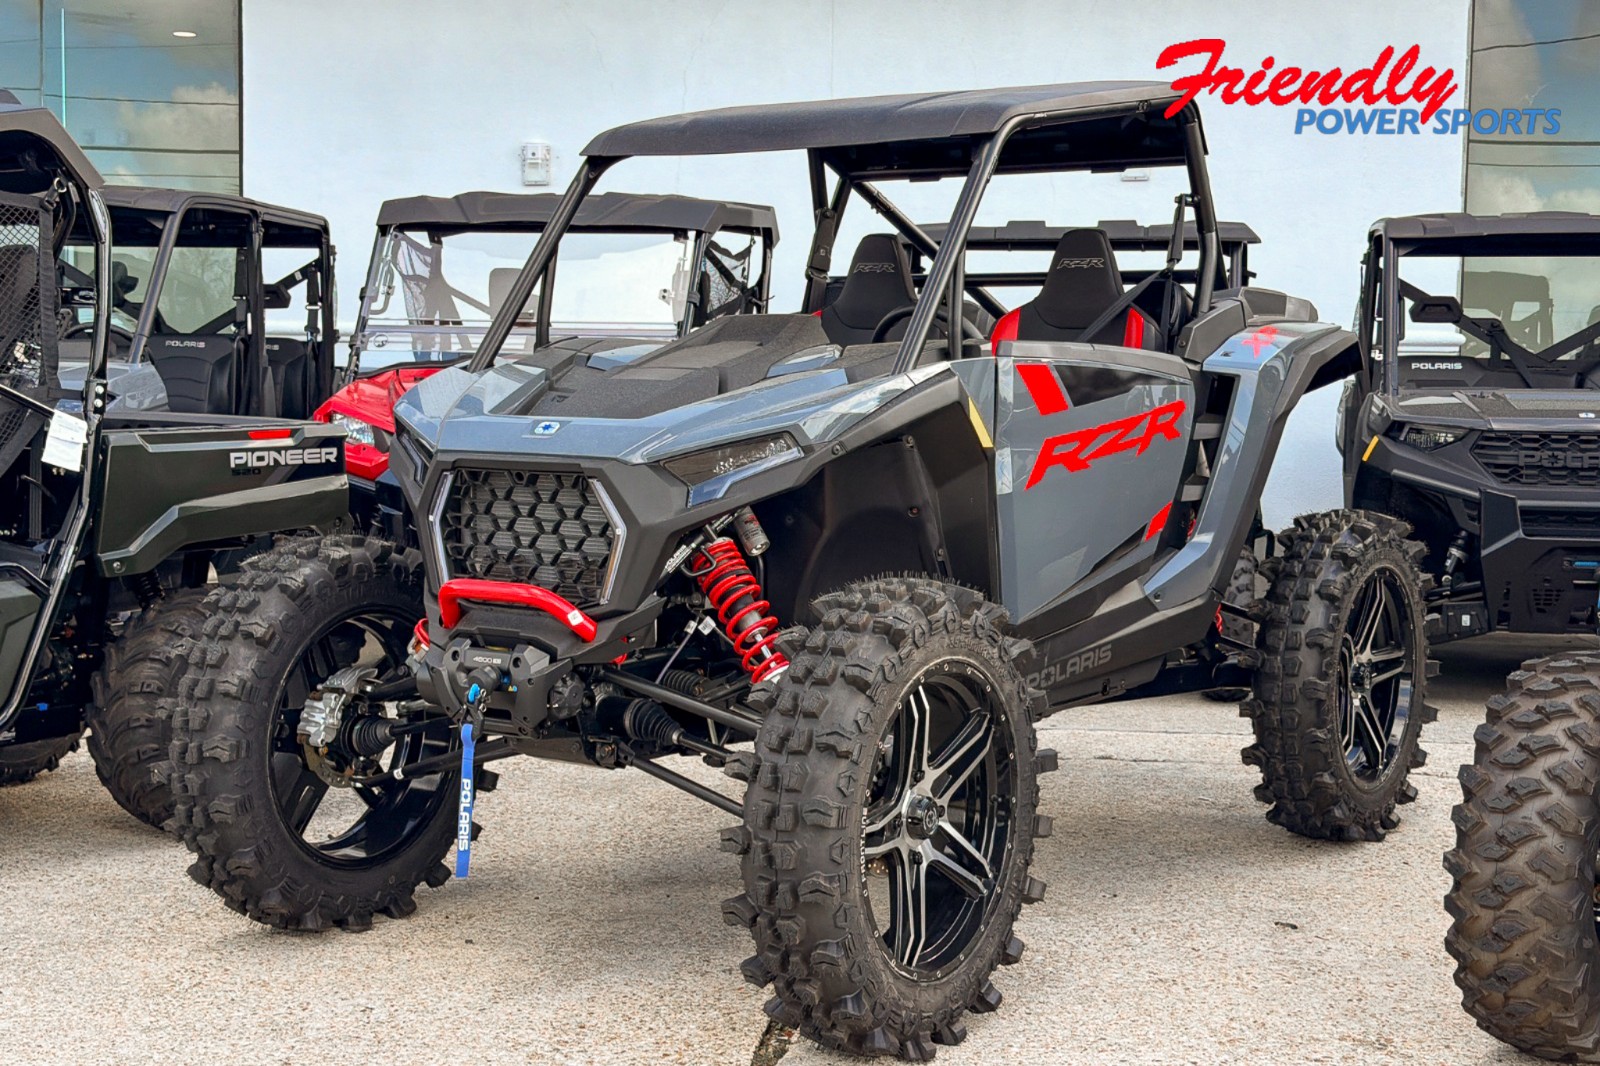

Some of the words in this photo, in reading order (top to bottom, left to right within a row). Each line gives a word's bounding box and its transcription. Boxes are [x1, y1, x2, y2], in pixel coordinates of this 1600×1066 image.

[854, 262, 895, 273] RZR
[1057, 258, 1104, 269] RZR
[1411, 362, 1463, 370] POLARIS
[1025, 399, 1186, 491] RZR
[229, 447, 338, 469] PIONEER
[1027, 643, 1113, 688] POLARIS
[458, 778, 472, 852] POLARIS
